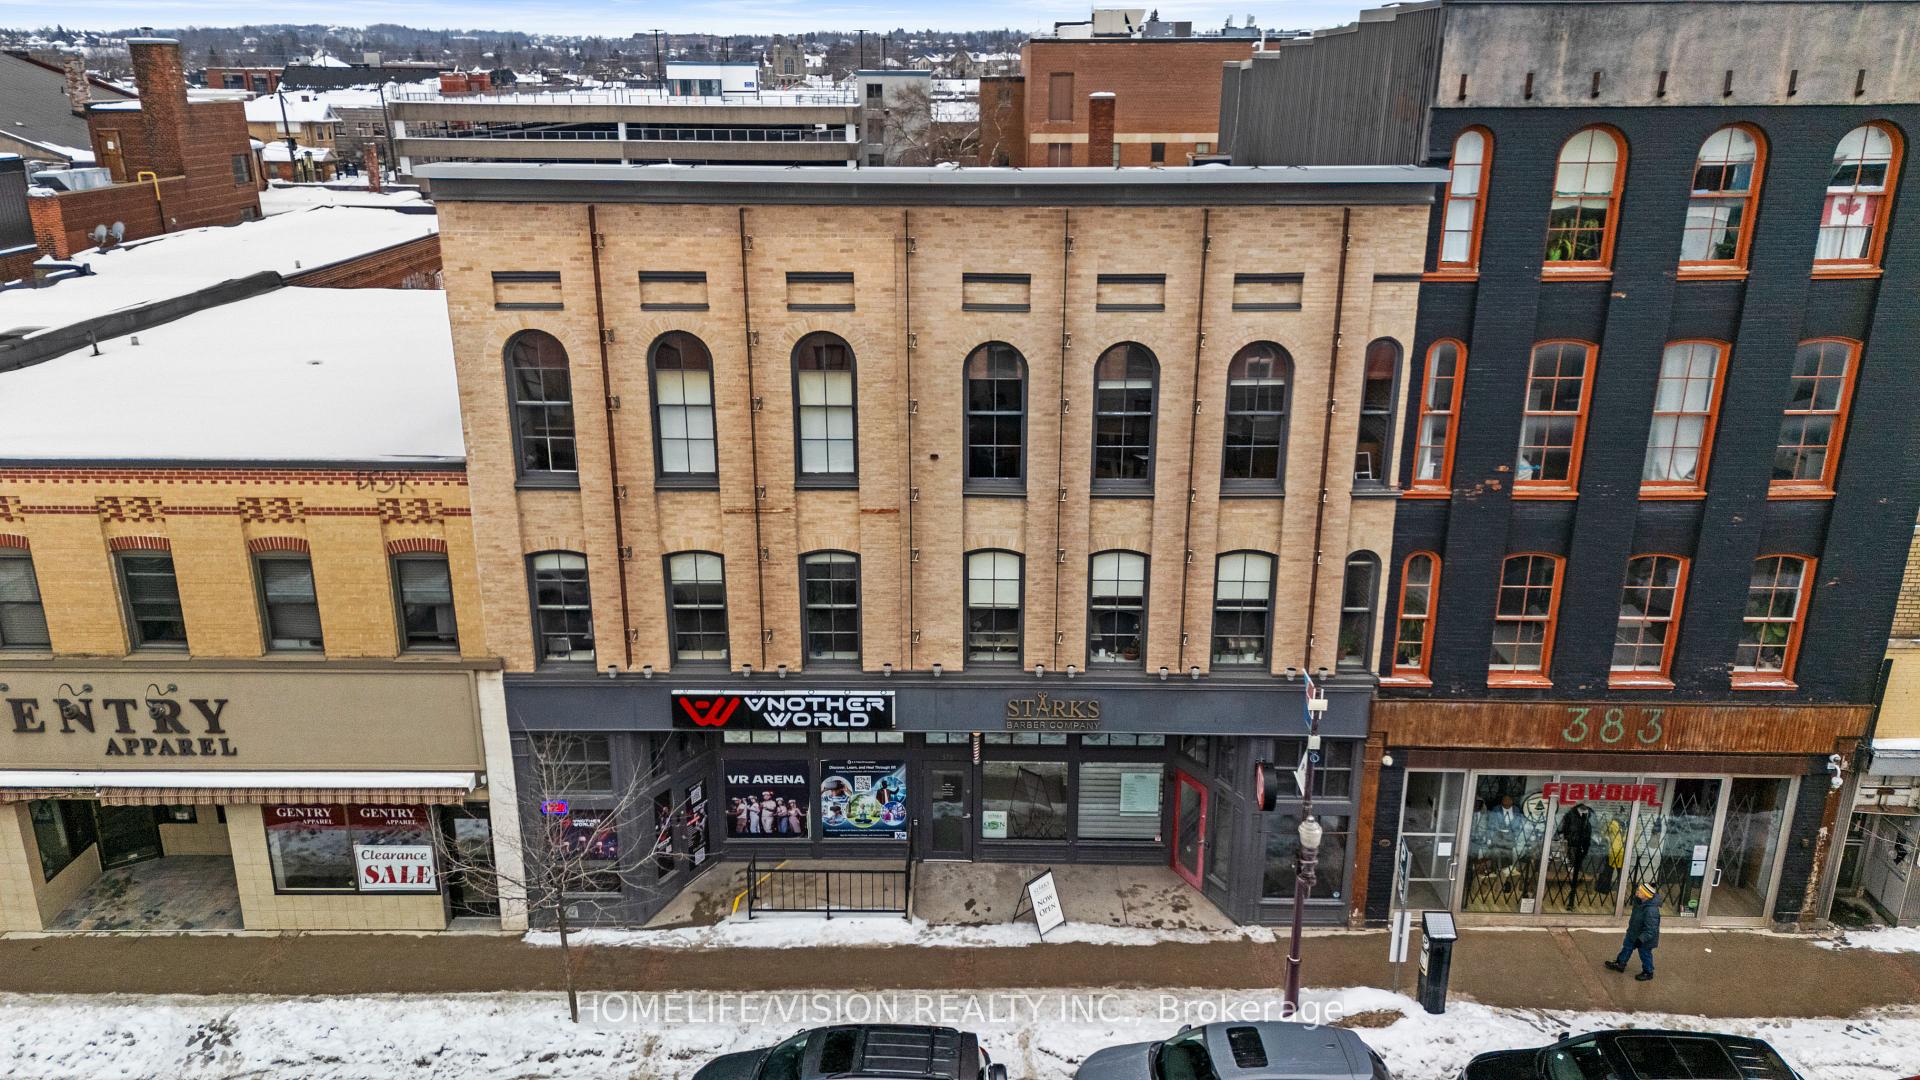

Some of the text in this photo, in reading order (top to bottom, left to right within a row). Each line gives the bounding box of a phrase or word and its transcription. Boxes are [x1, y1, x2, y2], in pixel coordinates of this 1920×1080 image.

[1007, 692, 1100, 718] STARKS
[763, 712, 870, 727] WORLD
[1006, 721, 1100, 730] BARBER COMPANY
[1562, 707, 1665, 743] 383
[105, 737, 238, 756] APPAREL
[728, 775, 805, 784] VR ARENA
[276, 807, 332, 818] GENTRY
[360, 808, 416, 818] GENTRY
[361, 849, 428, 861] Clearance
[364, 864, 432, 885] SALE
